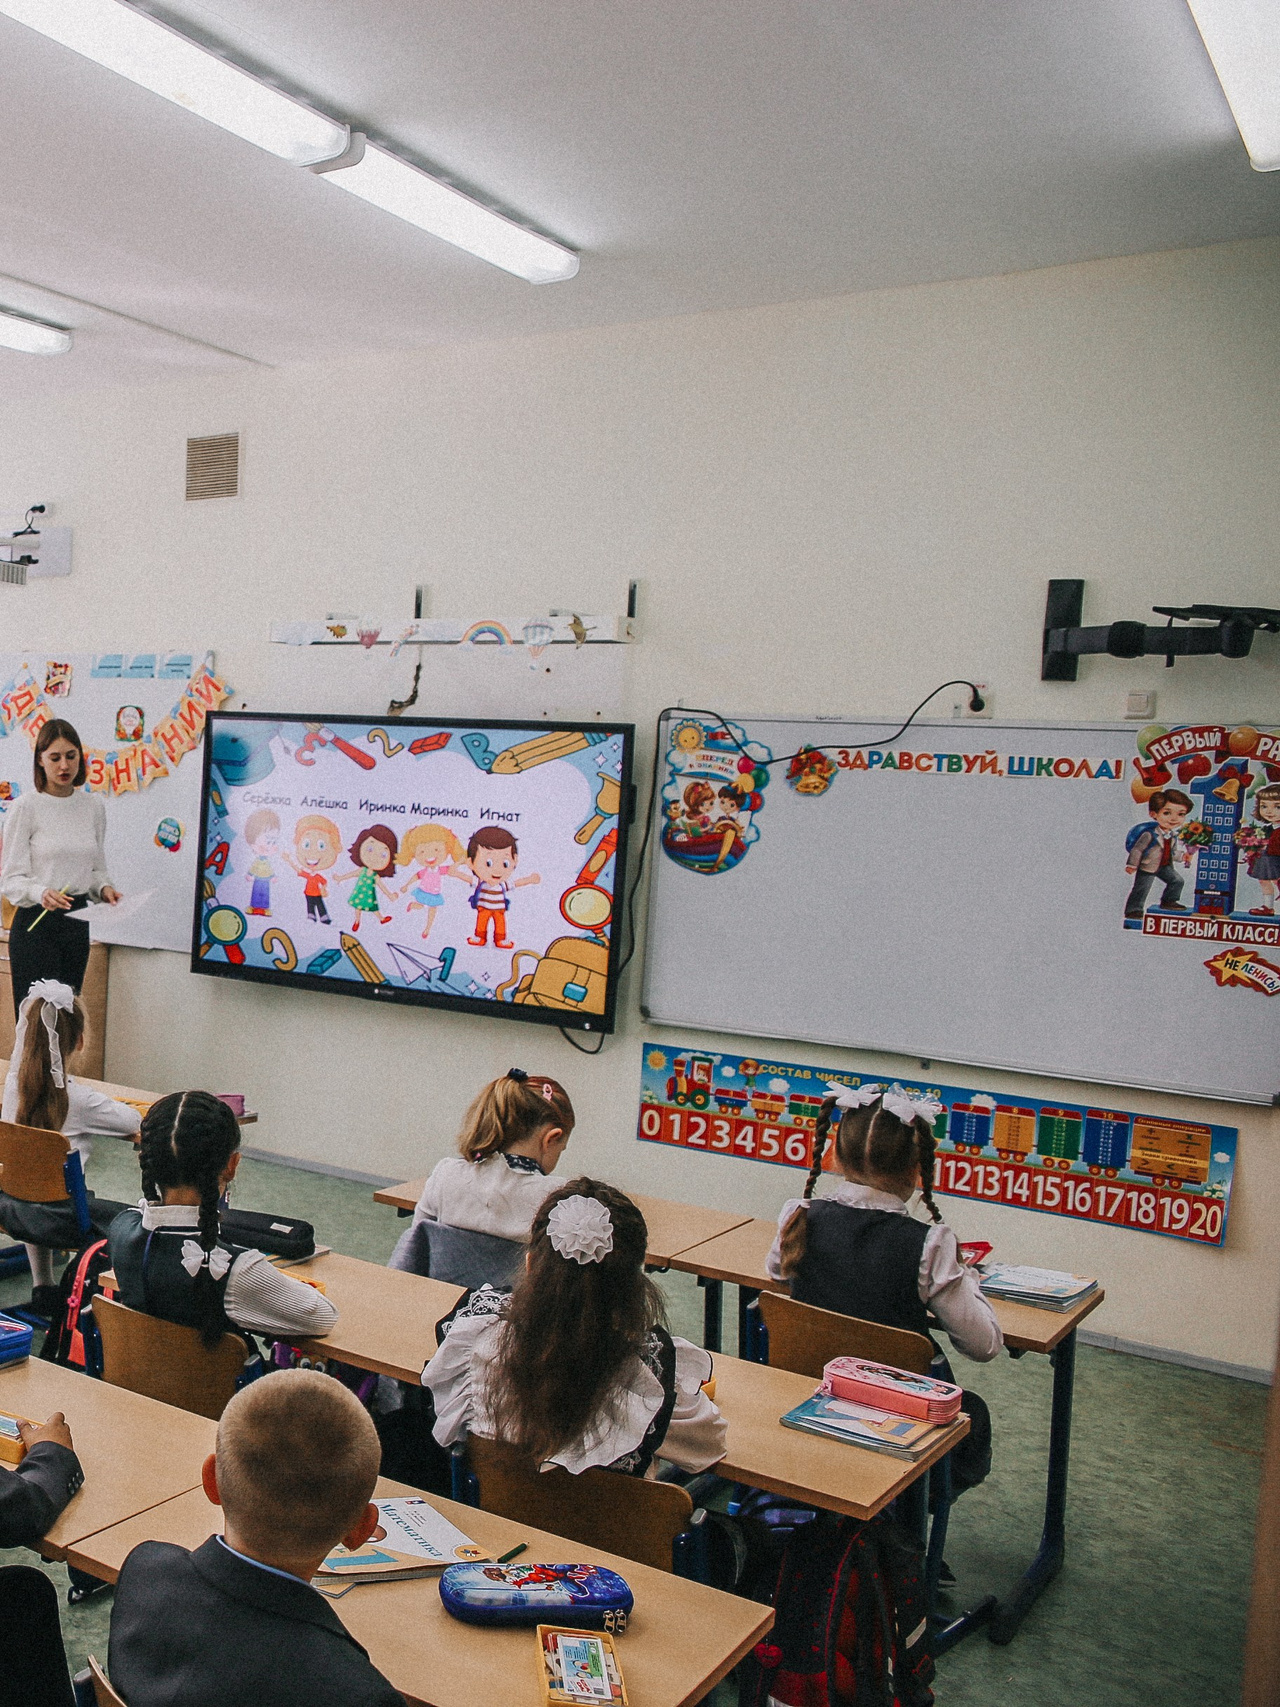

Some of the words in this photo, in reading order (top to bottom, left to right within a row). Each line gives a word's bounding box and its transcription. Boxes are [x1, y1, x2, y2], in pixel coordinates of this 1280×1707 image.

[1150, 728, 1221, 760] ПЕРВЫЙ
[837, 749, 1004, 777] ЗДРАВСТВУЙ,
[1007, 756, 1124, 780] ШКОЛА!
[242, 791, 291, 806] Серёжка
[300, 795, 348, 810] Алёшка
[358, 798, 406, 815] Иринка
[410, 802, 469, 819] Маринка
[480, 807, 521, 822] Игнат
[1145, 917, 1156, 933] В
[1160, 917, 1218, 938] ПЕРВЫЙ
[1222, 924, 1279, 943] КЛАСС!
[1224, 958, 1241, 972] НЕ
[1241, 963, 1280, 991] ЛЕНИСЬ!
[760, 1064, 812, 1079] СОСТАВ
[816, 1071, 861, 1087] ЧИСЕЛ
[642, 1109, 661, 1136] 0
[669, 1113, 682, 1141] 1
[687, 1116, 707, 1146] 2
[711, 1120, 731, 1149] 3
[735, 1125, 755, 1153] 4
[759, 1128, 780, 1157] 5
[784, 1133, 806, 1162] 6
[945, 1160, 971, 1192] 12
[974, 1164, 1001, 1197] 13
[1003, 1170, 1030, 1202] 14
[1033, 1175, 1061, 1207] 15
[1064, 1180, 1092, 1213] 16
[1095, 1185, 1125, 1218] 17
[1127, 1191, 1156, 1224] 18
[1160, 1196, 1190, 1230] 19
[1189, 1202, 1222, 1238] 20
[377, 1503, 444, 1557] Математика
